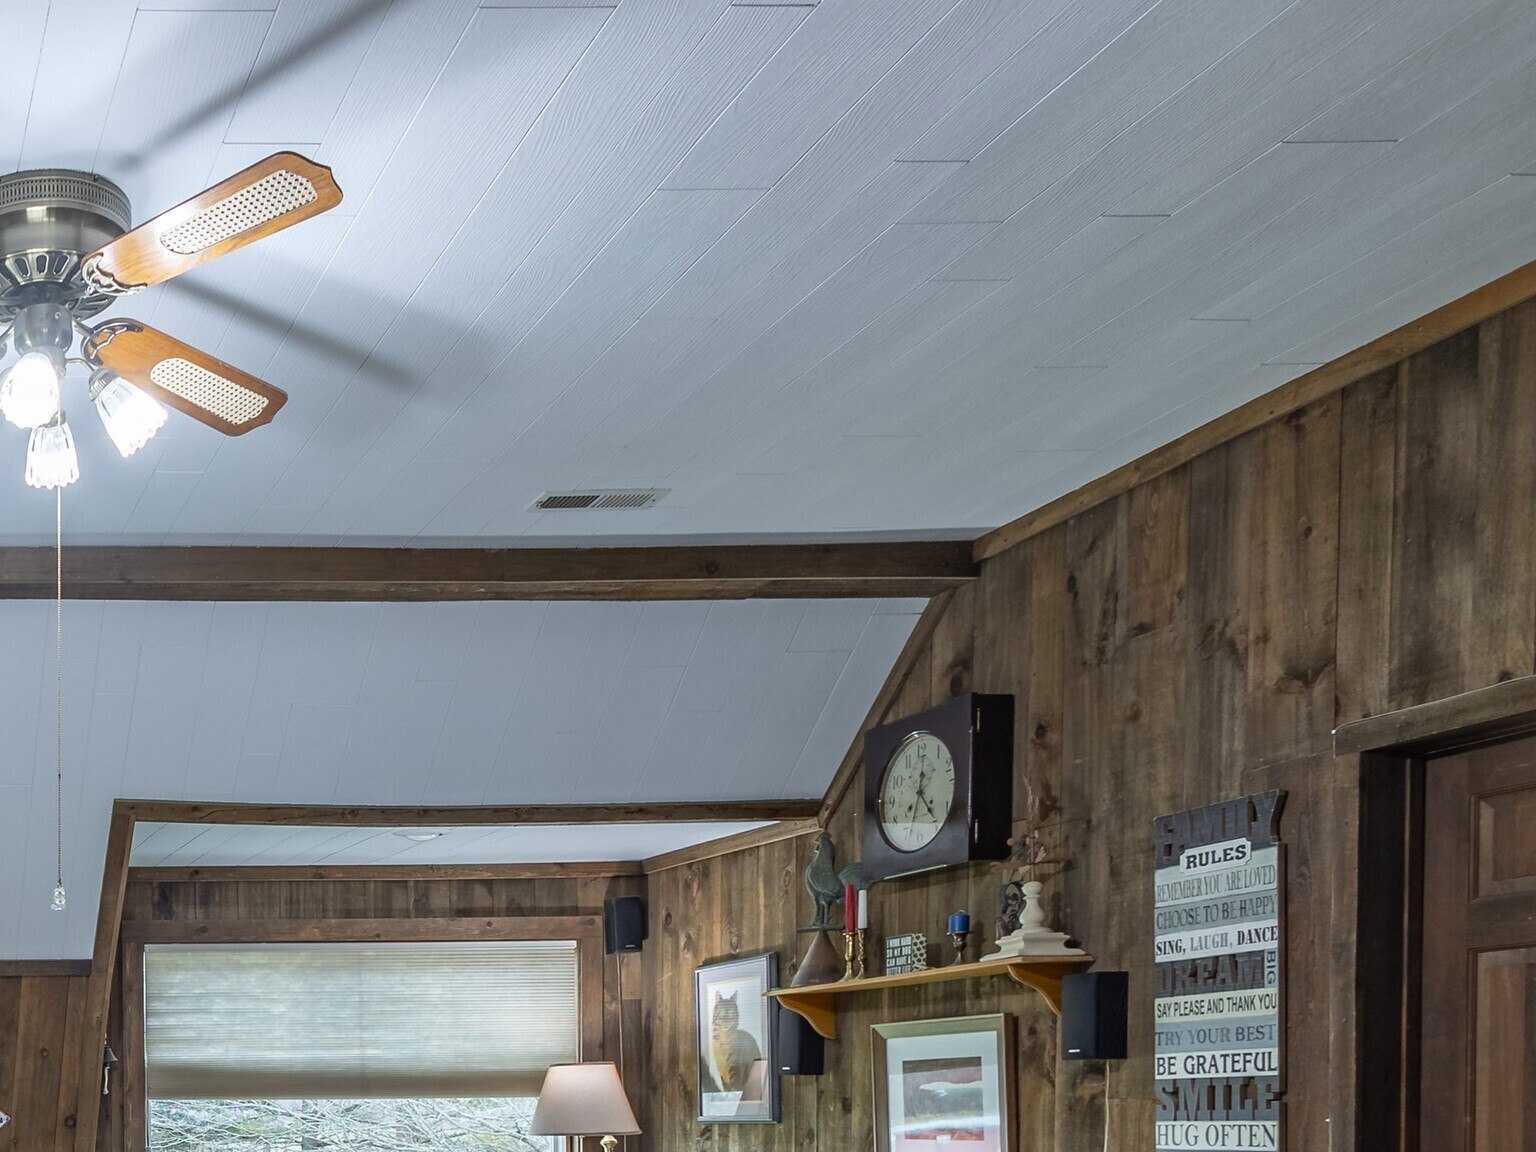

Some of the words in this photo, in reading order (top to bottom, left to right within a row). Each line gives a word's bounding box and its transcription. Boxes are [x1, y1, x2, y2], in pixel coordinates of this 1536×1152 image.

[893, 774, 903, 790] 10
[1185, 844, 1247, 870] RULES
[1156, 878, 1202, 903] REMEMBER
[1204, 873, 1223, 895] YOU
[1224, 870, 1242, 892] ARE
[1244, 864, 1275, 889] LOVED
[1156, 906, 1201, 930] CHOOSE
[1203, 904, 1219, 922] TO
[1222, 901, 1237, 920] BE
[1239, 894, 1277, 917] HAPPY
[1156, 939, 1186, 956] SING,
[1190, 932, 1233, 952] LAUGH,
[1237, 925, 1278, 946] DANCE
[1266, 951, 1276, 985] BIG
[1156, 1002, 1172, 1019] SAY
[1173, 999, 1205, 1017] PLEASE
[1207, 997, 1224, 1014] AND
[1226, 994, 1257, 1012] THANK
[1258, 993, 1277, 1010] YOU
[1155, 1030, 1184, 1047] TRY
[1187, 1027, 1230, 1045] YOUR
[1235, 1024, 1276, 1042] BEST
[1156, 1056, 1177, 1075] BE
[1183, 1051, 1278, 1075] GRATEFUL
[1156, 1078, 1279, 1121] SMILE
[1156, 1124, 1200, 1147] HUG
[1205, 1124, 1277, 1147] OFTEN
